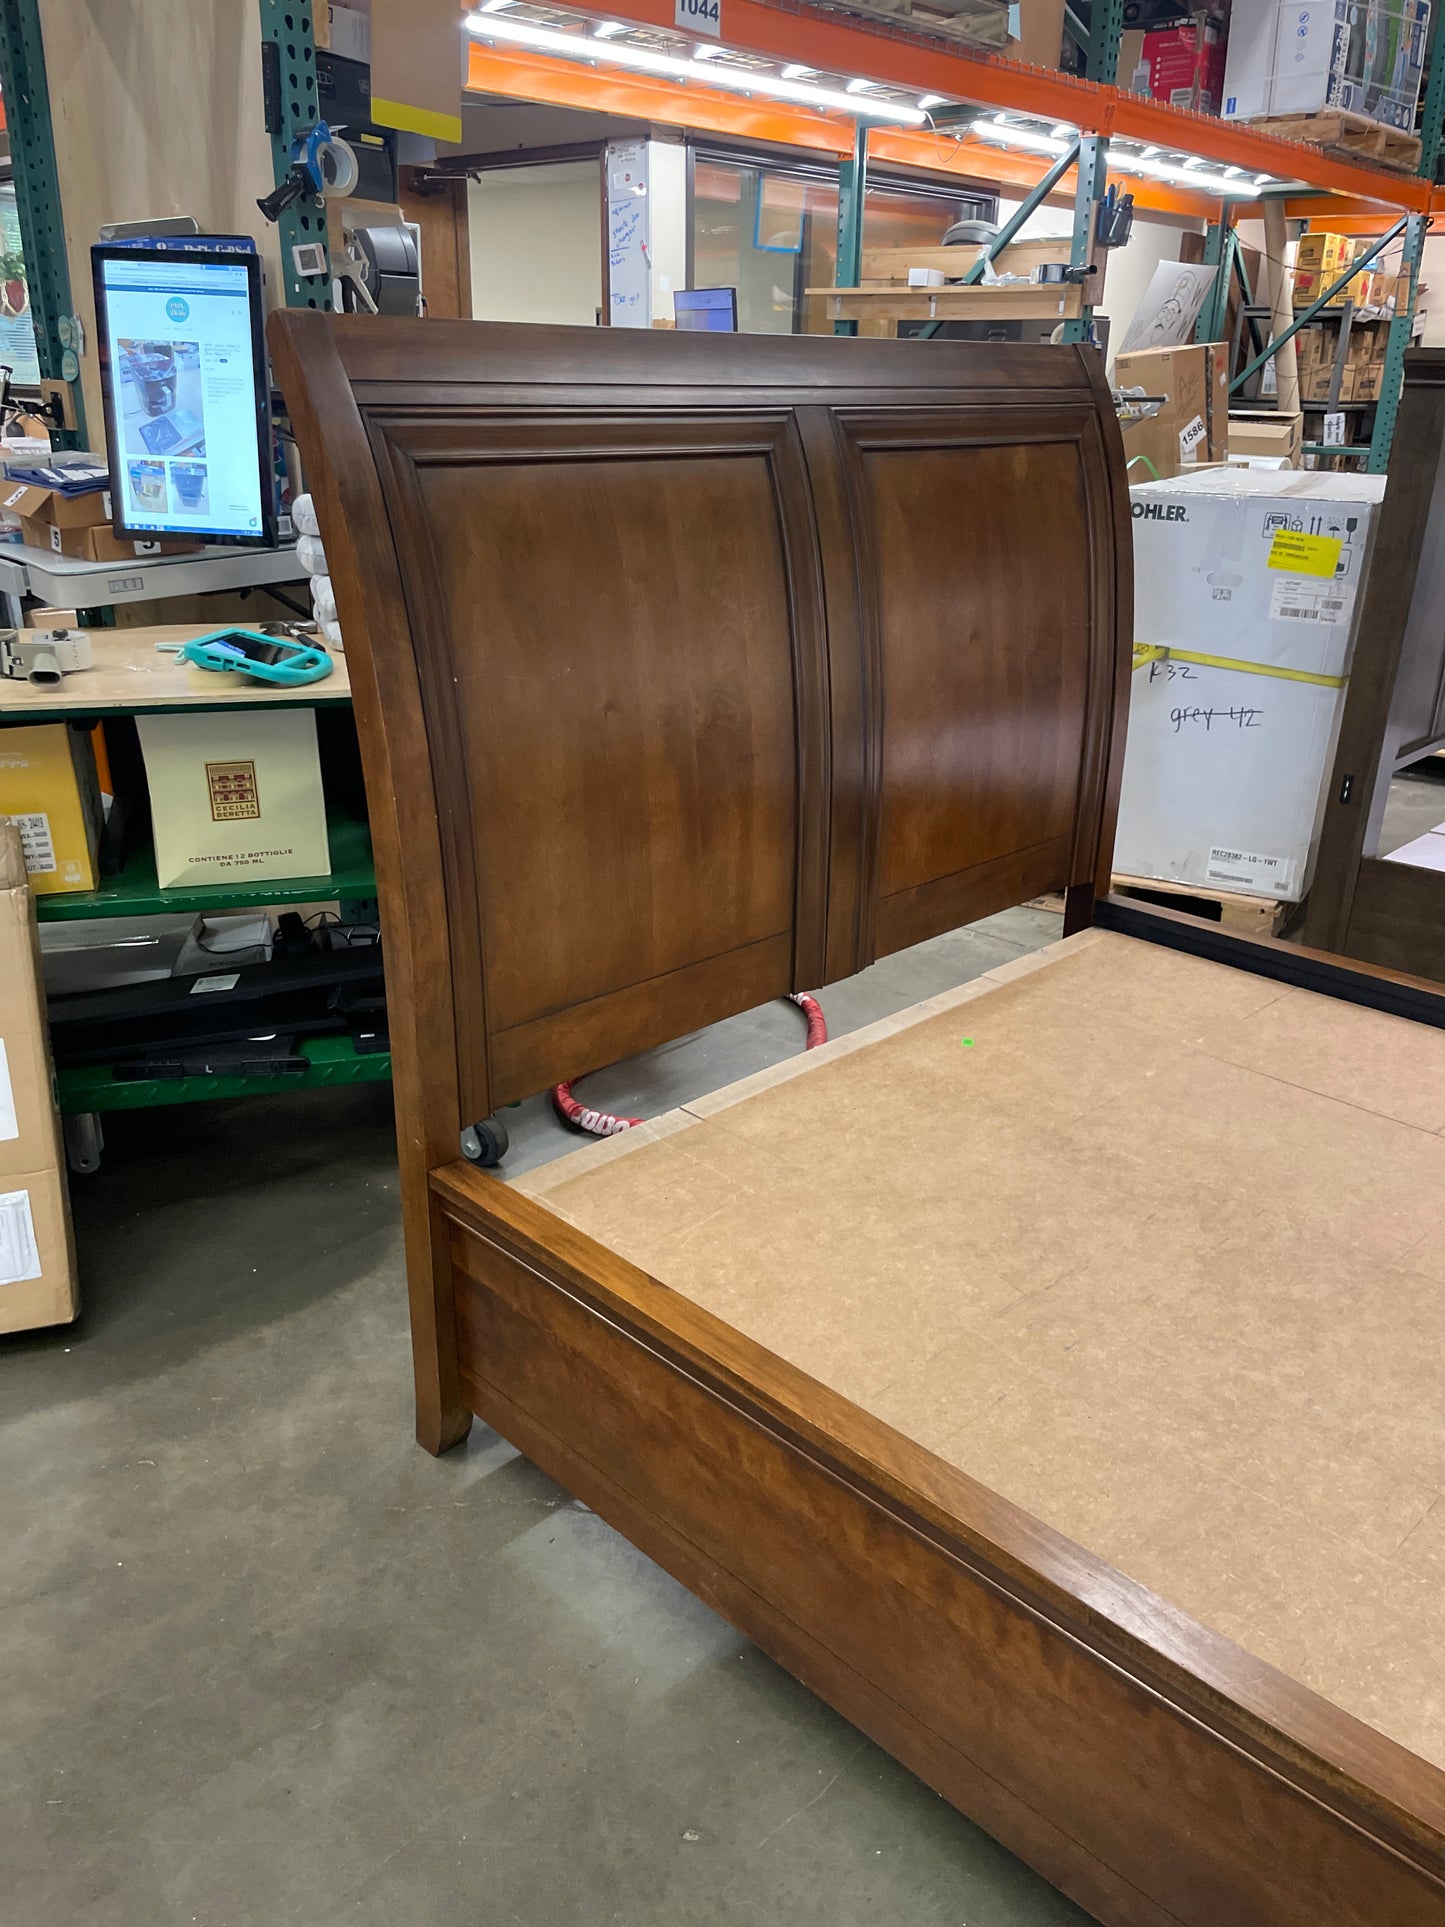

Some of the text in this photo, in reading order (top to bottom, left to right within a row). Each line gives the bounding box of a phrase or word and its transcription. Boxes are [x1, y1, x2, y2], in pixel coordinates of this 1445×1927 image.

[680, 0, 719, 22] 1044
[1182, 421, 1204, 445] 1586
[215, 803, 256, 812] CECILIA
[216, 809, 256, 818] BERETTA
[189, 855, 234, 863] CONTIENE
[248, 849, 293, 858] BOTTIGLIE
